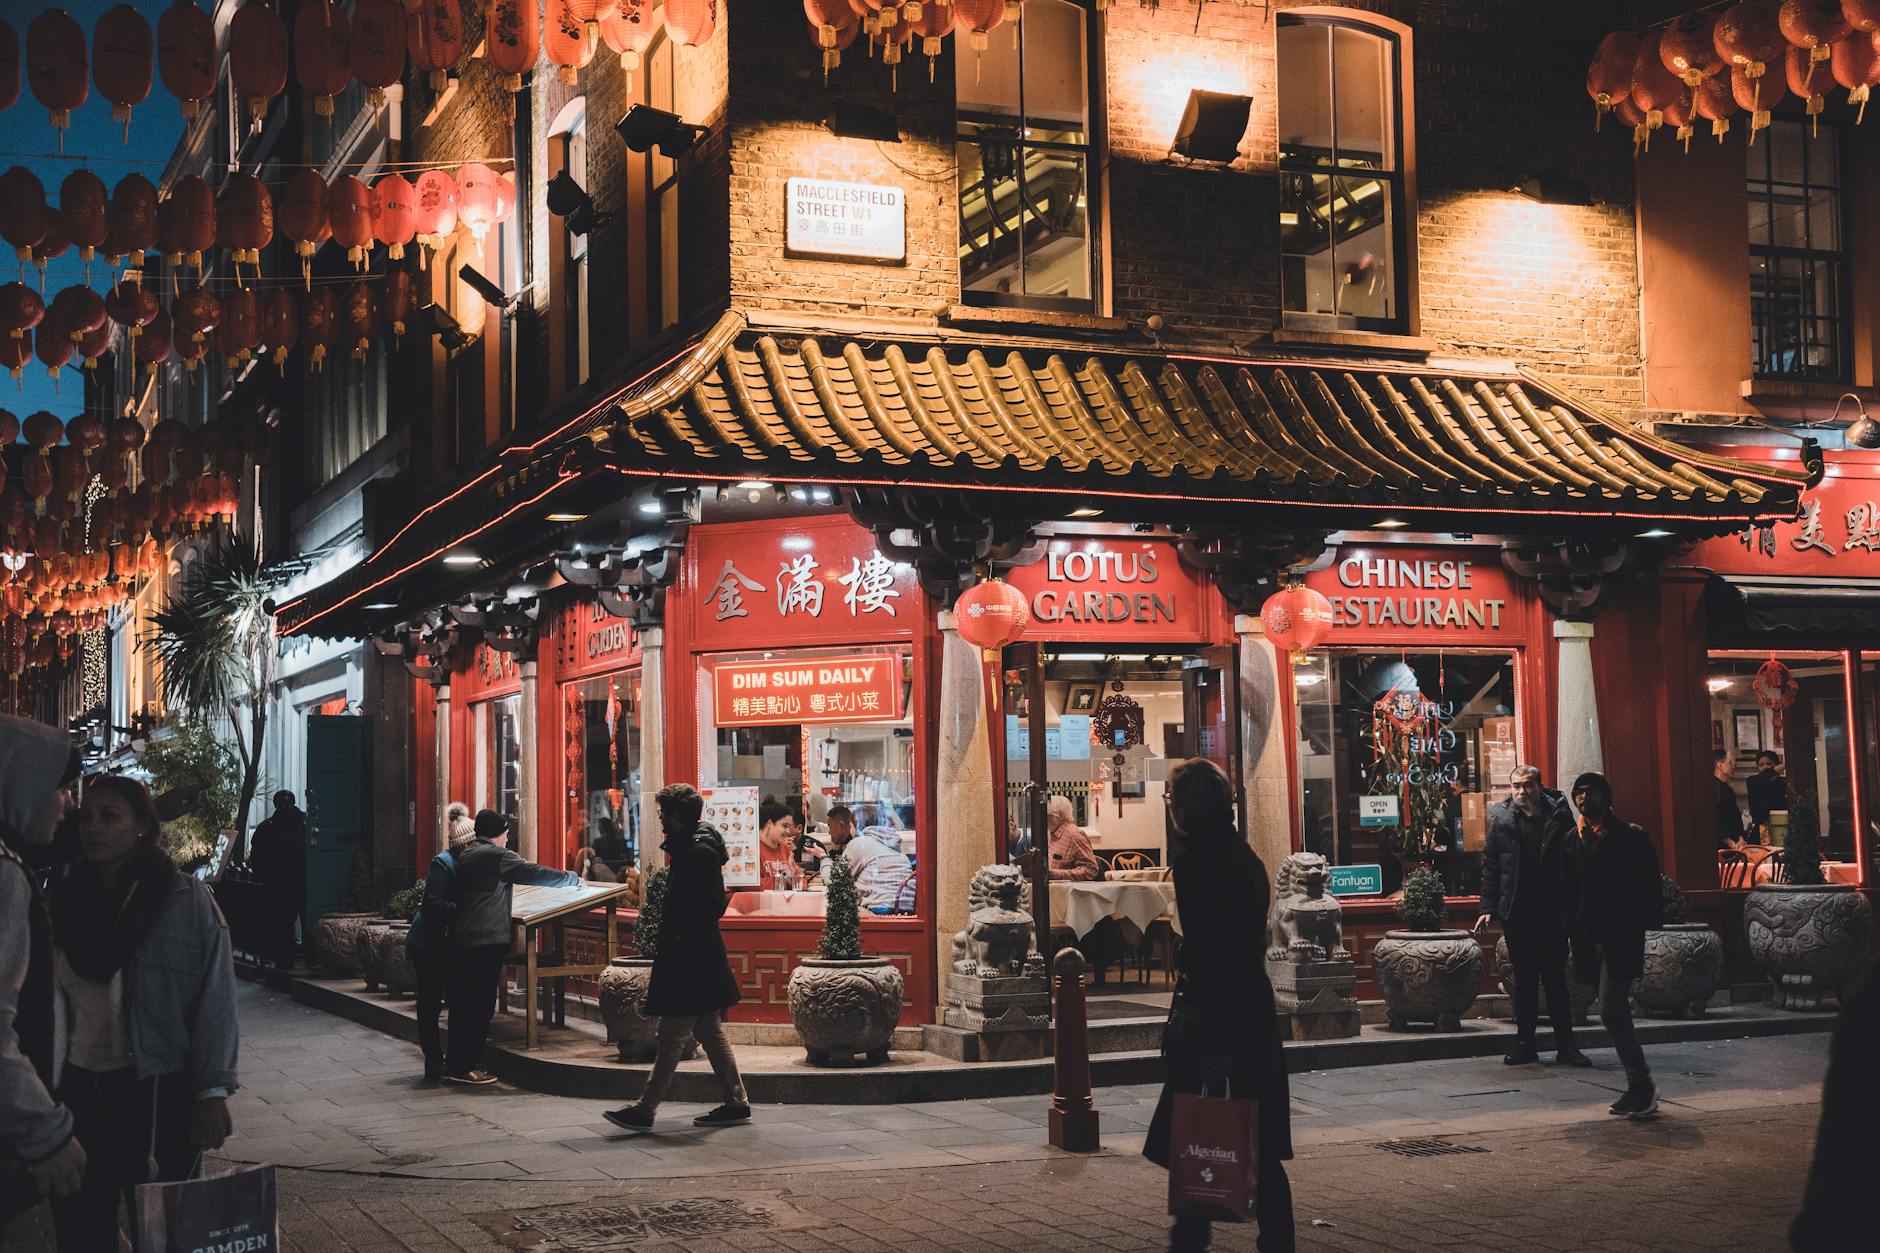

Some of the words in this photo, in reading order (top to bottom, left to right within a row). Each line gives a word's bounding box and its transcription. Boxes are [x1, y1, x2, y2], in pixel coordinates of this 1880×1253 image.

[797, 184, 896, 206] MACCLESFIELD
[797, 201, 846, 218] STREET
[852, 206, 872, 221] W1
[1048, 551, 1158, 582] LOTUS
[1339, 558, 1473, 589] CHINESE
[703, 550, 900, 621] 金滿樓
[1032, 590, 1175, 623] GARDEN
[1329, 596, 1505, 629] ESTAURANT
[732, 672, 768, 689] DIM
[772, 670, 814, 687] SUM
[818, 667, 874, 685] DAILY
[733, 695, 801, 717] 精美點心
[1332, 875, 1374, 887] Fantuan
[1180, 1144, 1238, 1163] Algerian
